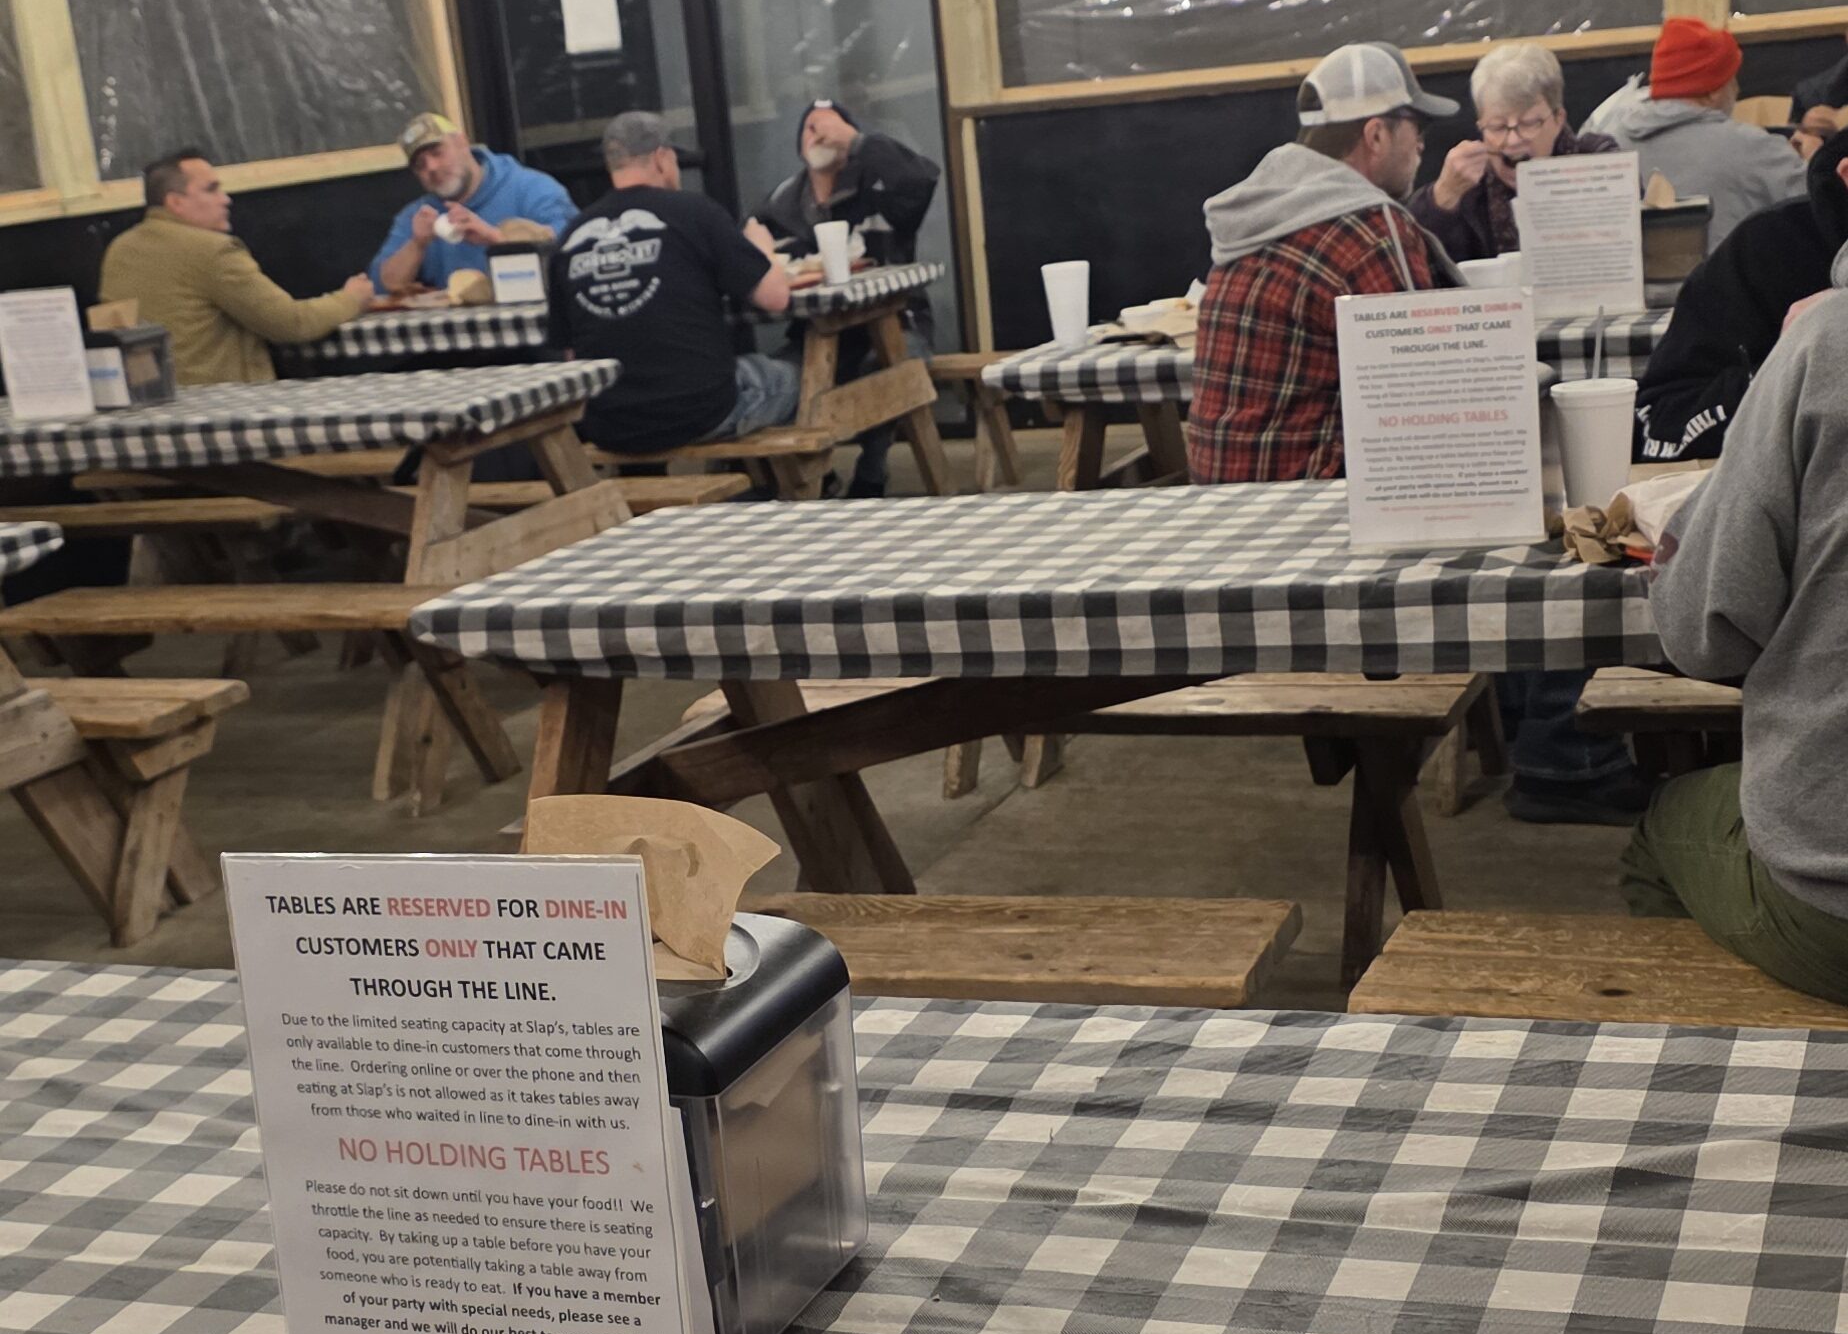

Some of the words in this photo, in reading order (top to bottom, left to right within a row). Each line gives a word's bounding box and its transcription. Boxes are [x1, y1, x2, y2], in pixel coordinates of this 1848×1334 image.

[1354, 312, 1387, 322] TABLES
[1389, 310, 1408, 320] ARE
[1411, 306, 1460, 318] RESERVED
[1462, 304, 1482, 314] FOR
[1365, 326, 1426, 339] CUSTOMERS
[1455, 322, 1480, 332] THAT
[1482, 320, 1512, 331] CAME
[1391, 343, 1440, 354] THROUGH
[1443, 342, 1461, 351] THE
[1463, 340, 1488, 349] LINE.
[1378, 416, 1399, 427] NO
[1401, 412, 1460, 427] HOLDING
[1464, 409, 1509, 423] TABLES
[264, 895, 336, 915] TABLES
[342, 896, 382, 916] ARE
[387, 897, 490, 917] RESERVED
[496, 898, 540, 918] FOR
[545, 899, 627, 919] DINE-IN
[295, 936, 419, 957] CUSTOMERS
[425, 938, 477, 957] ONLY
[482, 940, 537, 959] THAT
[542, 941, 606, 961] CAME
[348, 977, 453, 998] THROUGH
[456, 980, 499, 999] THE
[504, 981, 556, 1001] LINE.
[281, 1012, 308, 1026] Due
[310, 1015, 325, 1026] to
[327, 1013, 349, 1027] the
[352, 1014, 398, 1029] limited
[400, 1017, 449, 1034] seating
[451, 1018, 506, 1036] capacity
[509, 1021, 524, 1033] at
[525, 1019, 569, 1037] Slap's,
[571, 1021, 614, 1036] tables
[617, 1026, 640, 1037] are
[286, 1034, 313, 1051] only
[316, 1036, 373, 1051] available
[375, 1039, 390, 1052] to
[392, 1038, 438, 1053] dine-in
[441, 1042, 511, 1056] customers
[513, 1042, 542, 1057] that
[544, 1046, 583, 1059] come
[585, 1044, 641, 1063] through
[291, 1057, 313, 1071] the
[315, 1058, 344, 1072] line.
[350, 1059, 408, 1078] Ordering
[410, 1062, 452, 1077] online
[454, 1066, 470, 1077] or
[472, 1067, 503, 1078] over
[504, 1065, 529, 1080] the
[531, 1066, 575, 1083] phone
[578, 1068, 604, 1083] and
[607, 1068, 641, 1083] then
[296, 1081, 338, 1098] eating
[340, 1083, 354, 1095] at
[355, 1082, 393, 1099] Slap's
[395, 1084, 406, 1098] is
[408, 1086, 432, 1099] not
[434, 1085, 486, 1101] allowed
[489, 1091, 504, 1102] as
[506, 1088, 518, 1103] it
[519, 1089, 556, 1104] takes
[558, 1091, 600, 1106] tables
[603, 1095, 640, 1110] away
[310, 1102, 342, 1116] from
[345, 1104, 382, 1119] those
[384, 1106, 412, 1120] who
[415, 1108, 460, 1122] waited
[463, 1110, 476, 1123] in
[479, 1110, 504, 1124] line
[506, 1114, 521, 1126] to
[524, 1113, 572, 1128] dine-in
[574, 1115, 607, 1129] with
[609, 1119, 630, 1130] us.
[338, 1137, 378, 1162] NO
[384, 1140, 507, 1170] HOLDING
[512, 1146, 610, 1175] TABLES
[305, 1179, 346, 1195] Please
[348, 1182, 366, 1196] do
[369, 1186, 391, 1198] not
[393, 1186, 410, 1199] sit
[412, 1186, 449, 1201] down
[452, 1189, 482, 1203] until
[485, 1193, 509, 1206] you
[512, 1192, 544, 1207] have
[547, 1197, 579, 1210] your
[582, 1195, 623, 1212] food!!
[629, 1199, 654, 1214] We
[311, 1202, 360, 1218] throttle
[362, 1205, 384, 1220] the
[386, 1206, 411, 1222] line
[414, 1211, 429, 1222] as
[432, 1211, 480, 1226] needed
[483, 1214, 499, 1227] to
[501, 1217, 547, 1230] ensure
[549, 1216, 586, 1233] there
[589, 1219, 601, 1233] is
[603, 1221, 653, 1239] seating
[318, 1227, 373, 1243] capacity.
[379, 1229, 395, 1245] By
[397, 1230, 440, 1247] taking
[441, 1235, 458, 1249] up
[461, 1236, 469, 1247] a
[472, 1235, 506, 1250] table
[509, 1236, 553, 1253] before
[555, 1243, 581, 1256] you
[583, 1242, 617, 1257] have
[619, 1247, 651, 1260] your
[319, 1270, 377, 1284] someone
[380, 1273, 408, 1287] who
[410, 1274, 421, 1288] is
[425, 1277, 460, 1293] ready
[463, 1280, 477, 1292] to
[480, 1283, 506, 1294] eat.
[512, 1281, 523, 1295] If
[525, 1285, 551, 1298] you
[553, 1284, 588, 1300] have
[591, 1290, 600, 1300] a
[603, 1290, 661, 1306] member
[342, 1291, 356, 1304] of
[358, 1295, 389, 1307] your
[391, 1298, 426, 1312] party
[428, 1298, 458, 1313] with
[461, 1303, 508, 1317] special
[511, 1306, 555, 1323] needs,
[558, 1308, 603, 1323] please
[607, 1314, 630, 1325] see
[633, 1316, 642, 1326] a
[324, 1315, 381, 1330] manager
[384, 1317, 409, 1331] and
[410, 1322, 431, 1333] we
[433, 1321, 458, 1334] will
